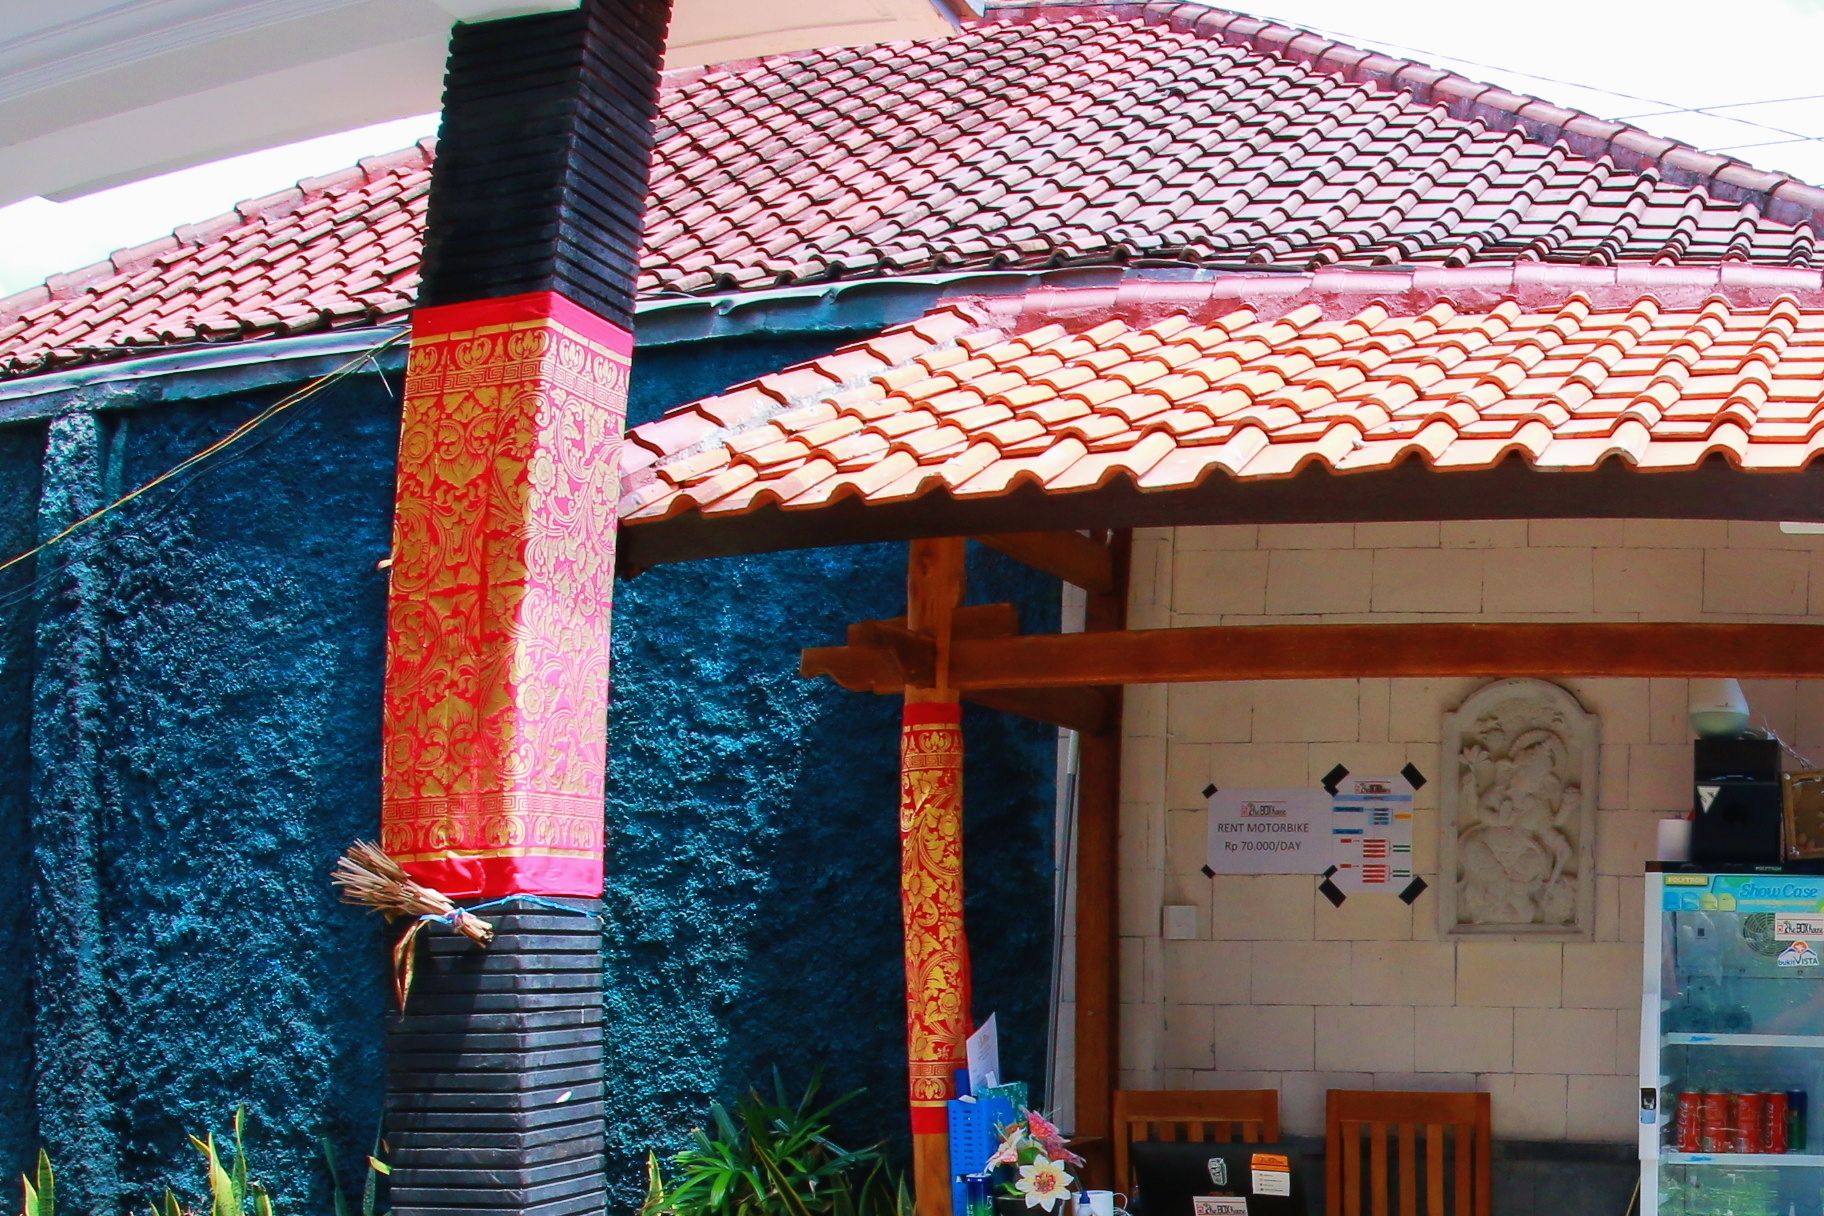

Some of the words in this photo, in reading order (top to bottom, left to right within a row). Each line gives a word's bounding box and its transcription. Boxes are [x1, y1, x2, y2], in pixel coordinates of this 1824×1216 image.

[1217, 823, 1245, 833] RENT
[1247, 823, 1310, 833] MOTORBIKE
[1225, 841, 1238, 852] Rp
[1241, 841, 1302, 852] 70.000/DAY
